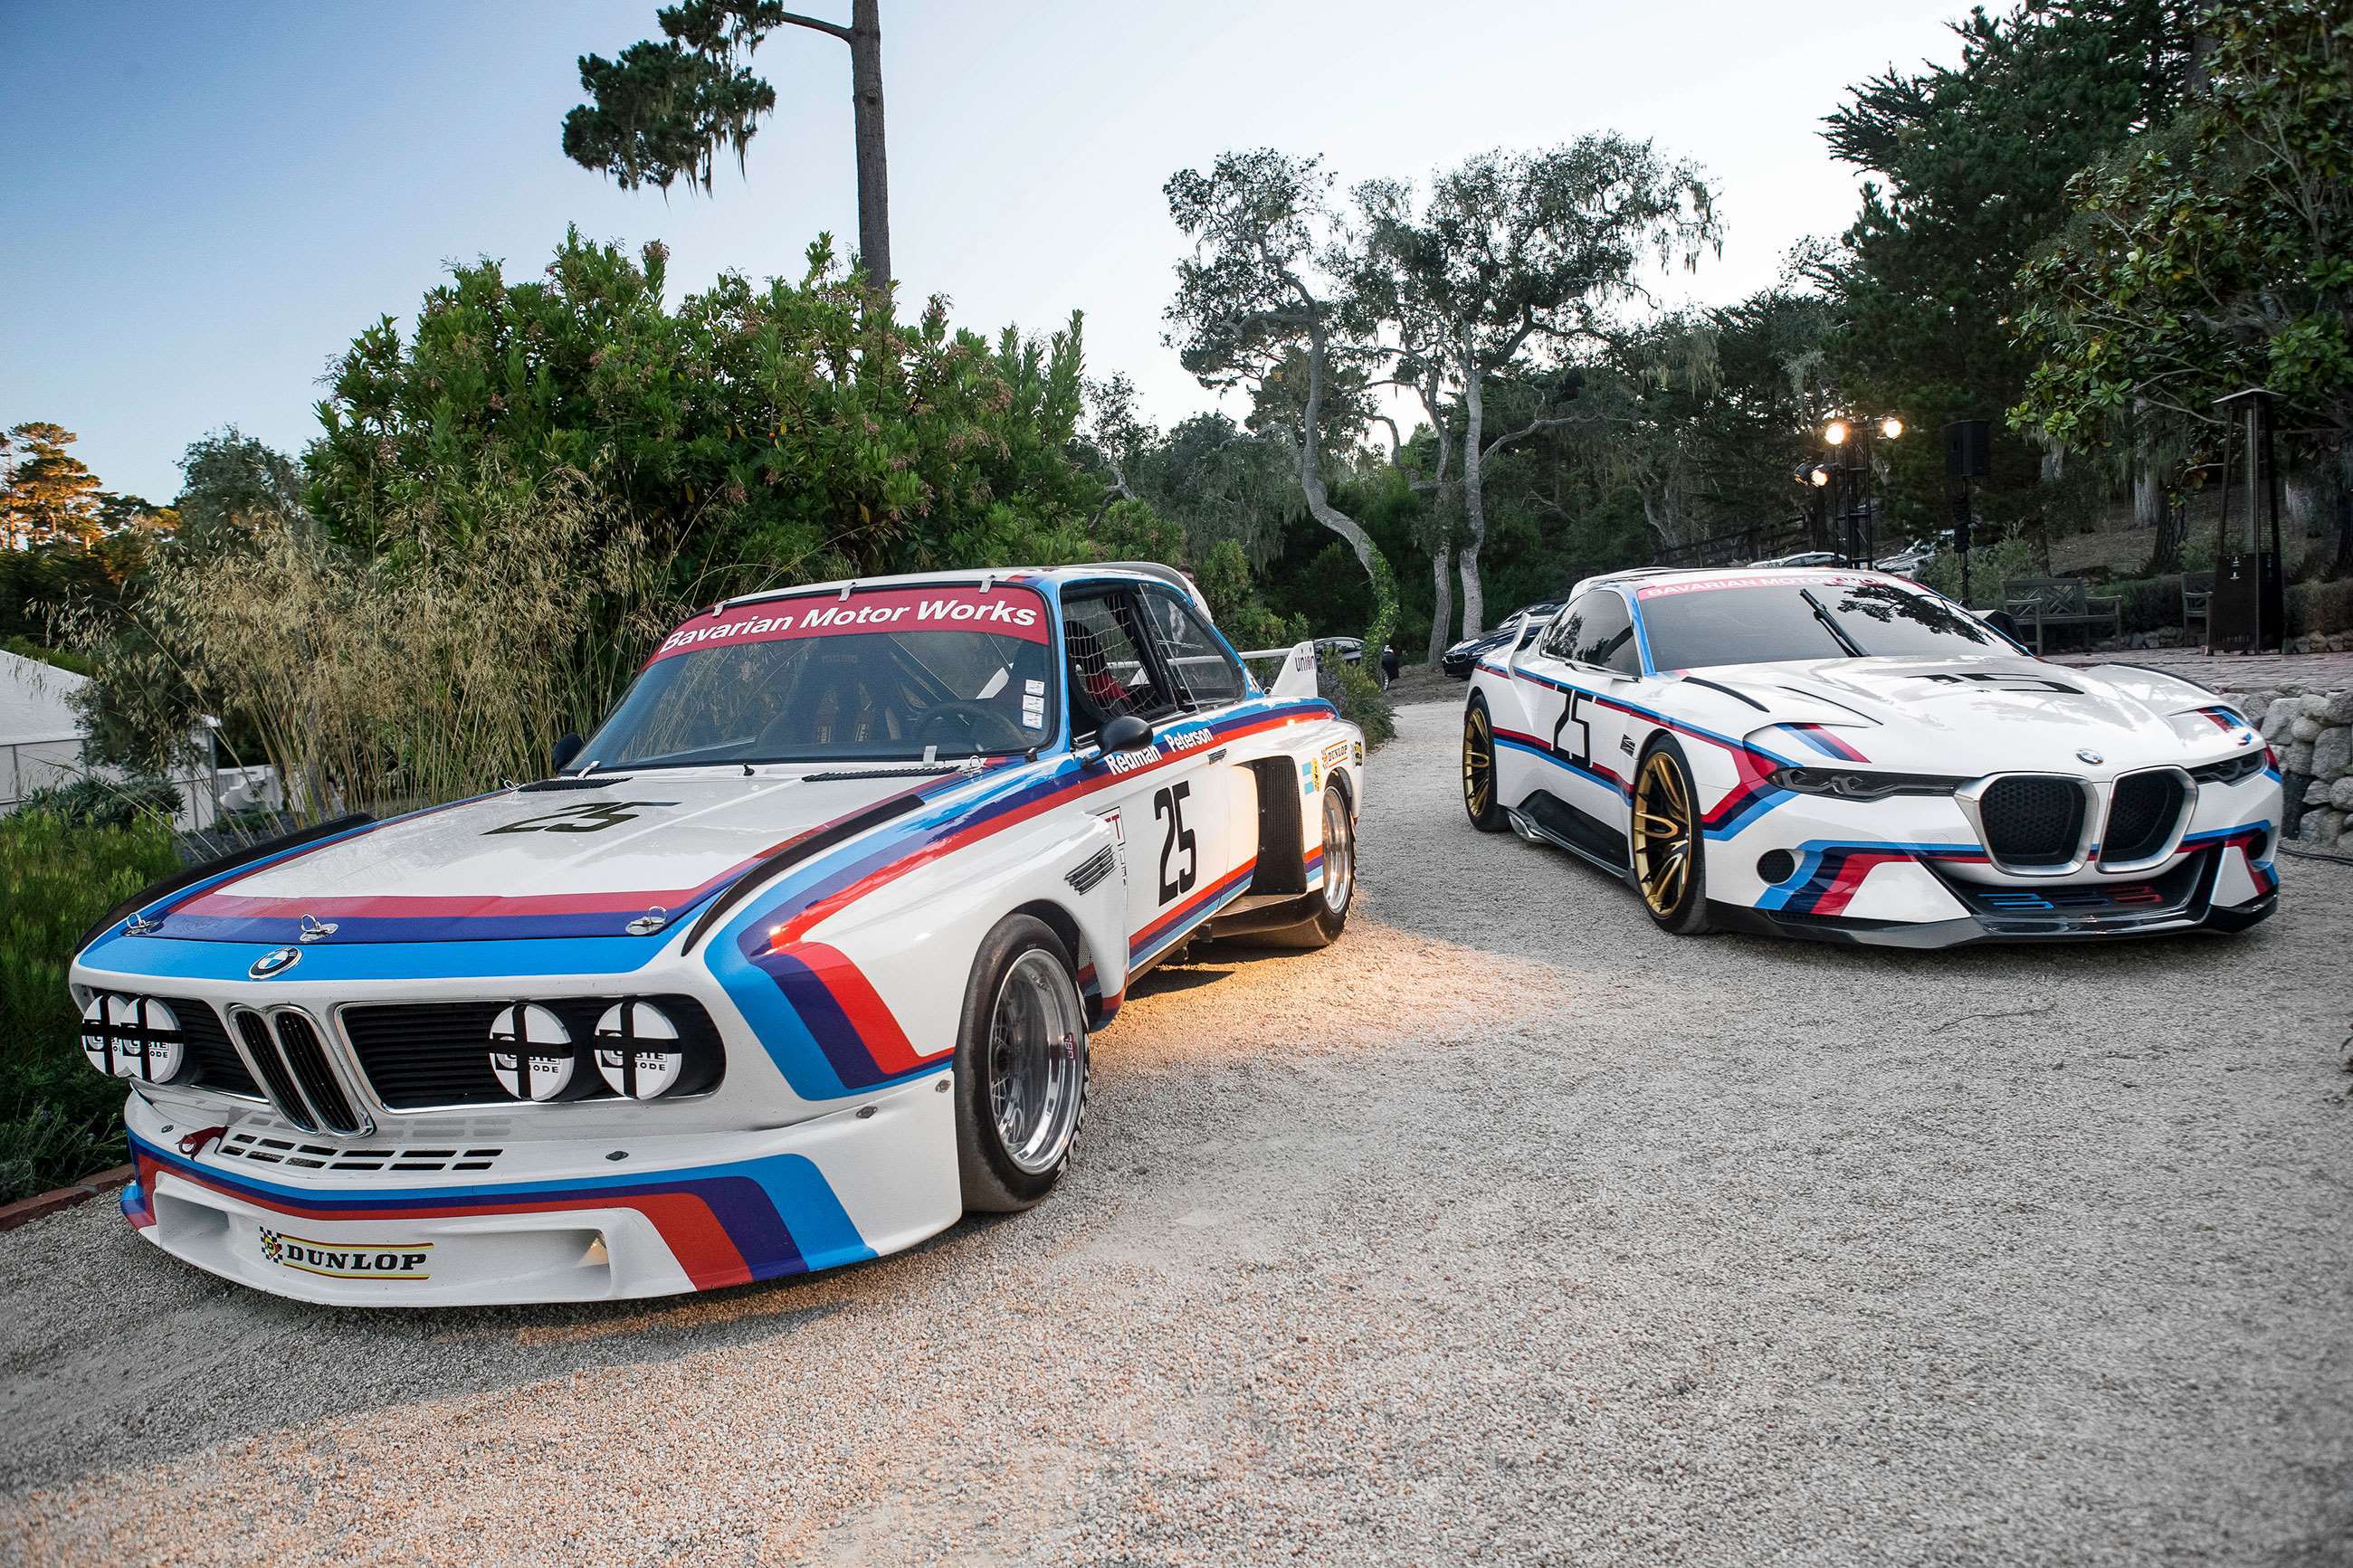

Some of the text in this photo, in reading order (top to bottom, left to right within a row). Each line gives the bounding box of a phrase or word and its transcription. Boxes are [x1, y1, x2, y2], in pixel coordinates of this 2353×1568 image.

[1646, 579, 1756, 597] BAVARIAN
[658, 600, 1038, 655] Bavarian Motor Works
[1552, 684, 1596, 768] 25
[1103, 727, 1215, 776] Redman Peterson
[1328, 744, 1348, 762] DUNLOP
[479, 801, 683, 834] 25
[1154, 780, 1197, 908] 25
[286, 1243, 428, 1271] DUNLOP
